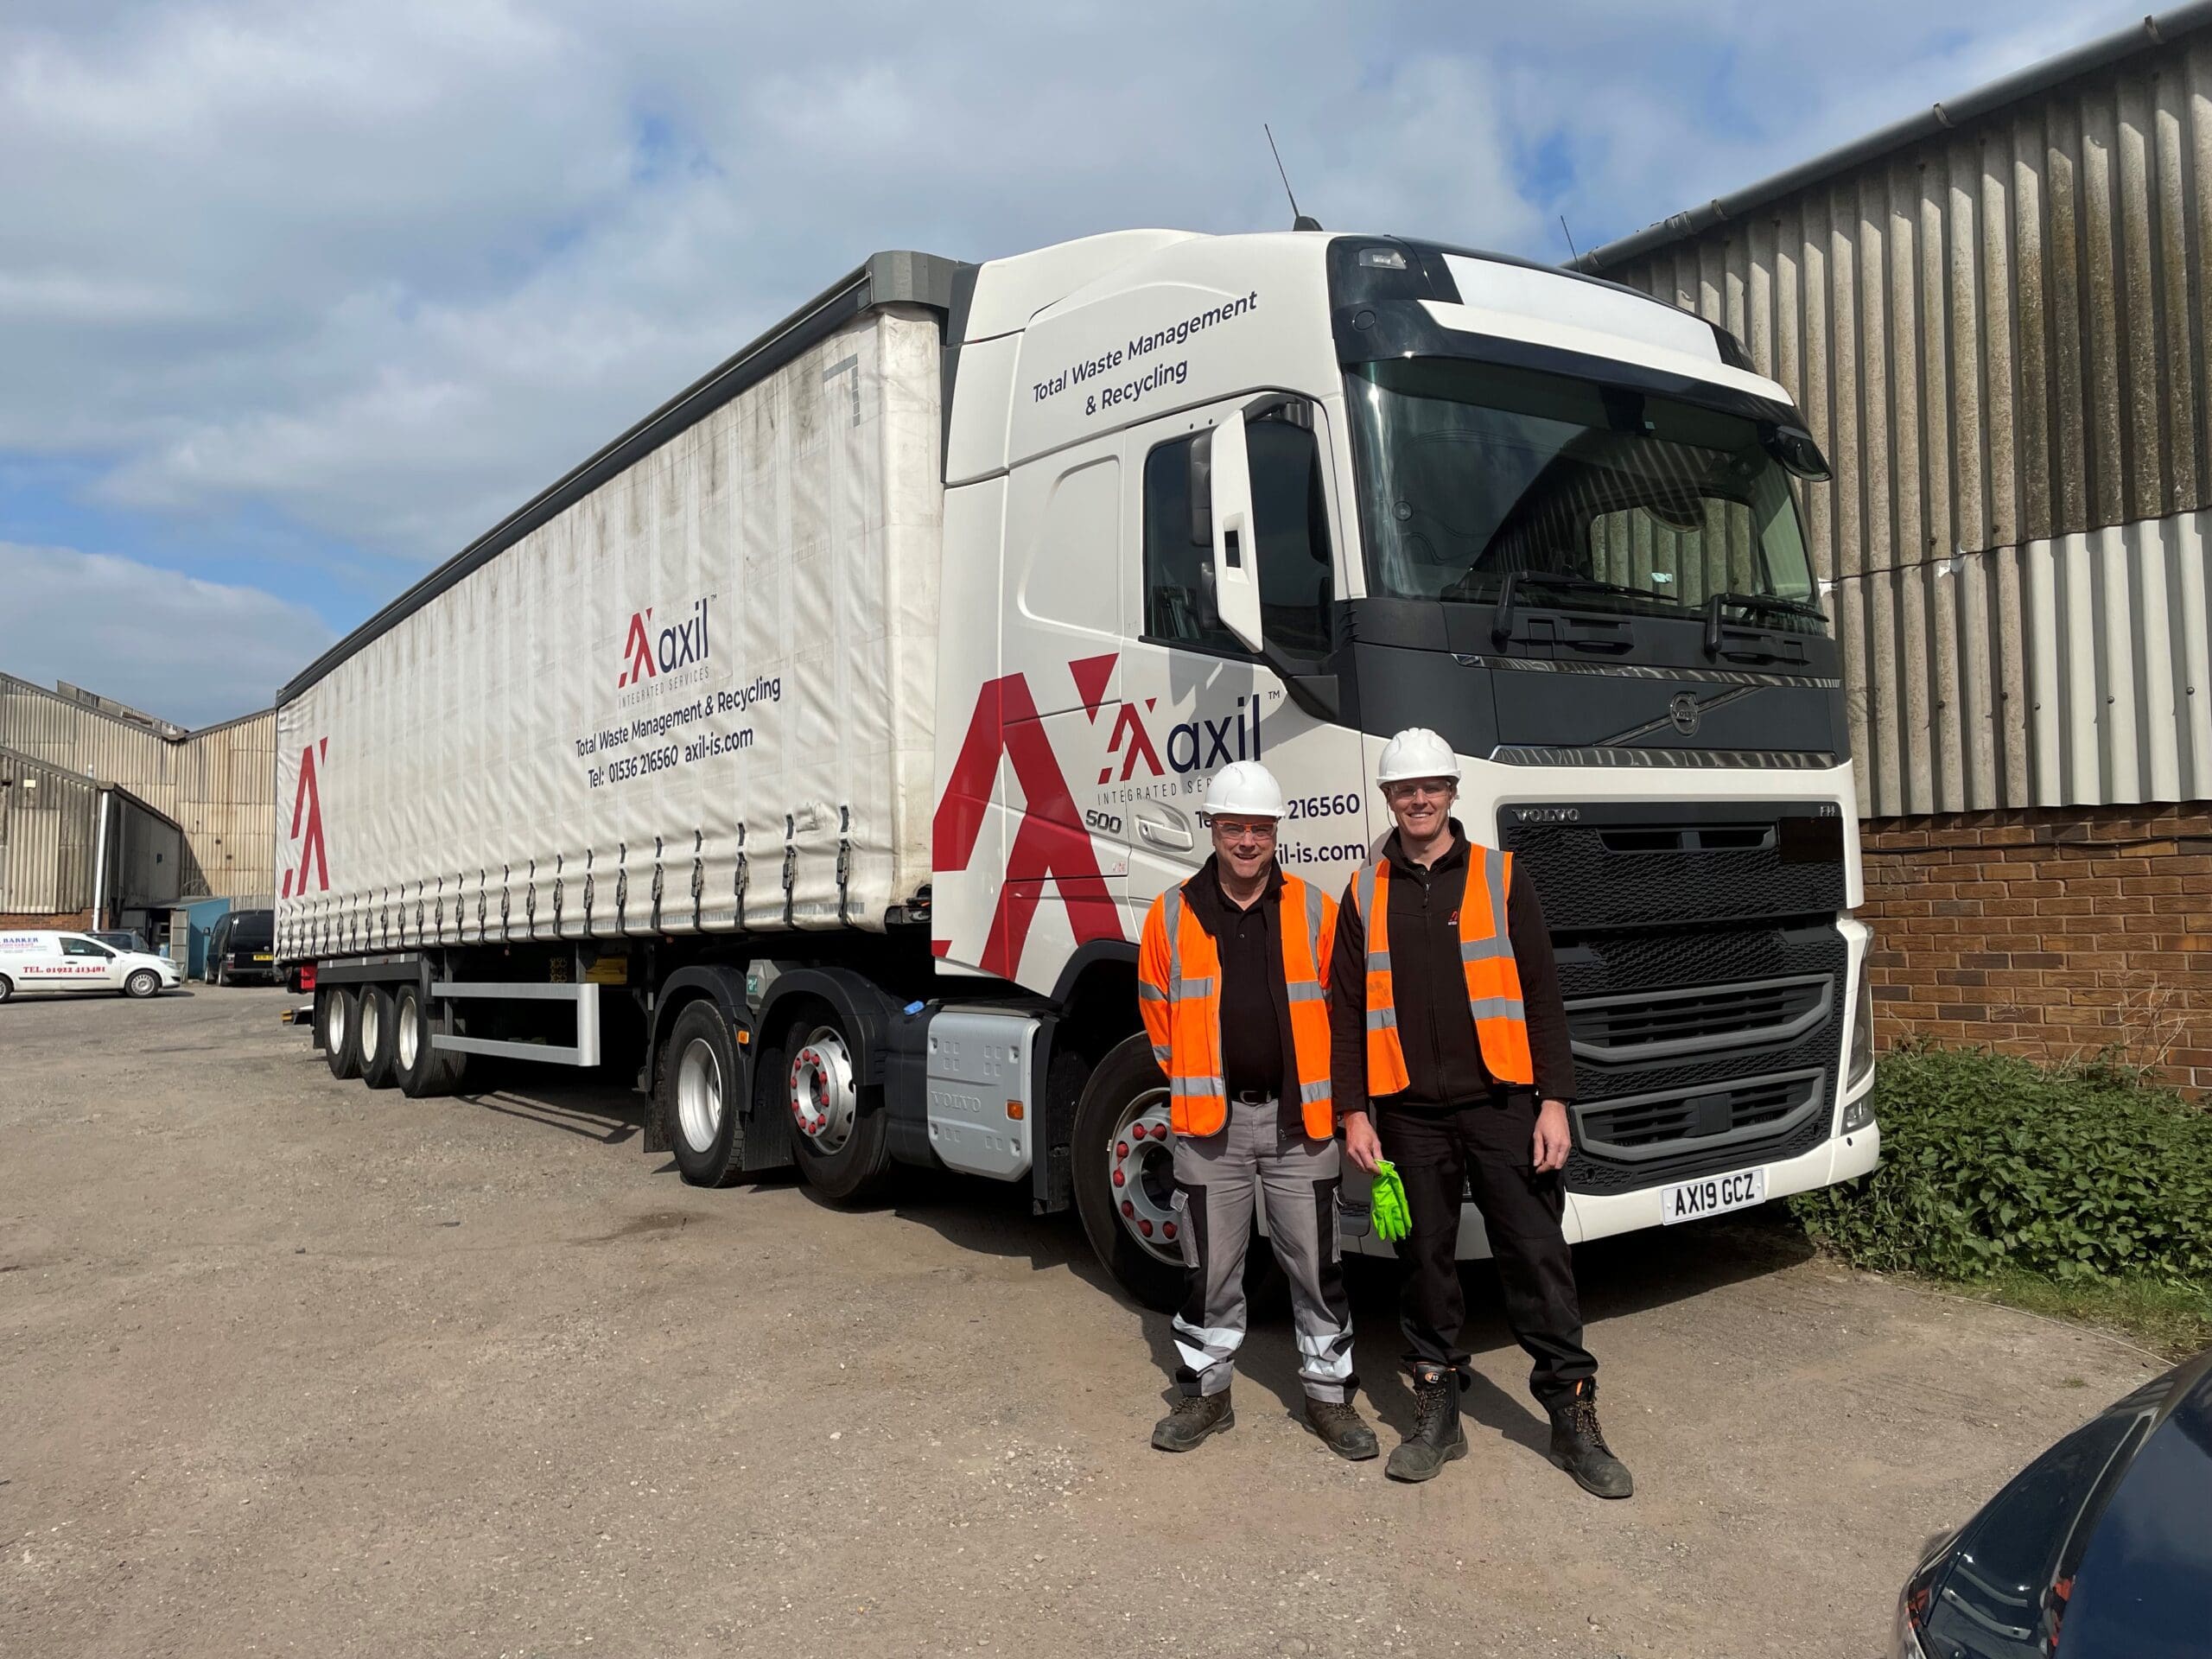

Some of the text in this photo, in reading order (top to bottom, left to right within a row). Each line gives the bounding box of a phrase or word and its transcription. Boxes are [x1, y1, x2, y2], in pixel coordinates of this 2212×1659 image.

[1033, 289, 1258, 404] Total Waste Management
[1085, 359, 1188, 416] & Recycling
[658, 597, 709, 674] axil
[619, 666, 709, 709] INTEGRATED SERVICES
[575, 676, 781, 758] Total Waste Management & Recycling
[1166, 694, 1262, 773] axil
[588, 727, 753, 789] Tel: 01536 216560 axil-is.com
[1097, 783, 1178, 806] INTEGRATED
[1288, 793, 1360, 819] 216560
[1511, 808, 1580, 823] VOLVO
[1086, 810, 1122, 834] 500
[1274, 842, 1365, 865] il-is.com
[931, 1091, 982, 1112] VOLVO
[1675, 1173, 1755, 1217] AX19 GCZ
